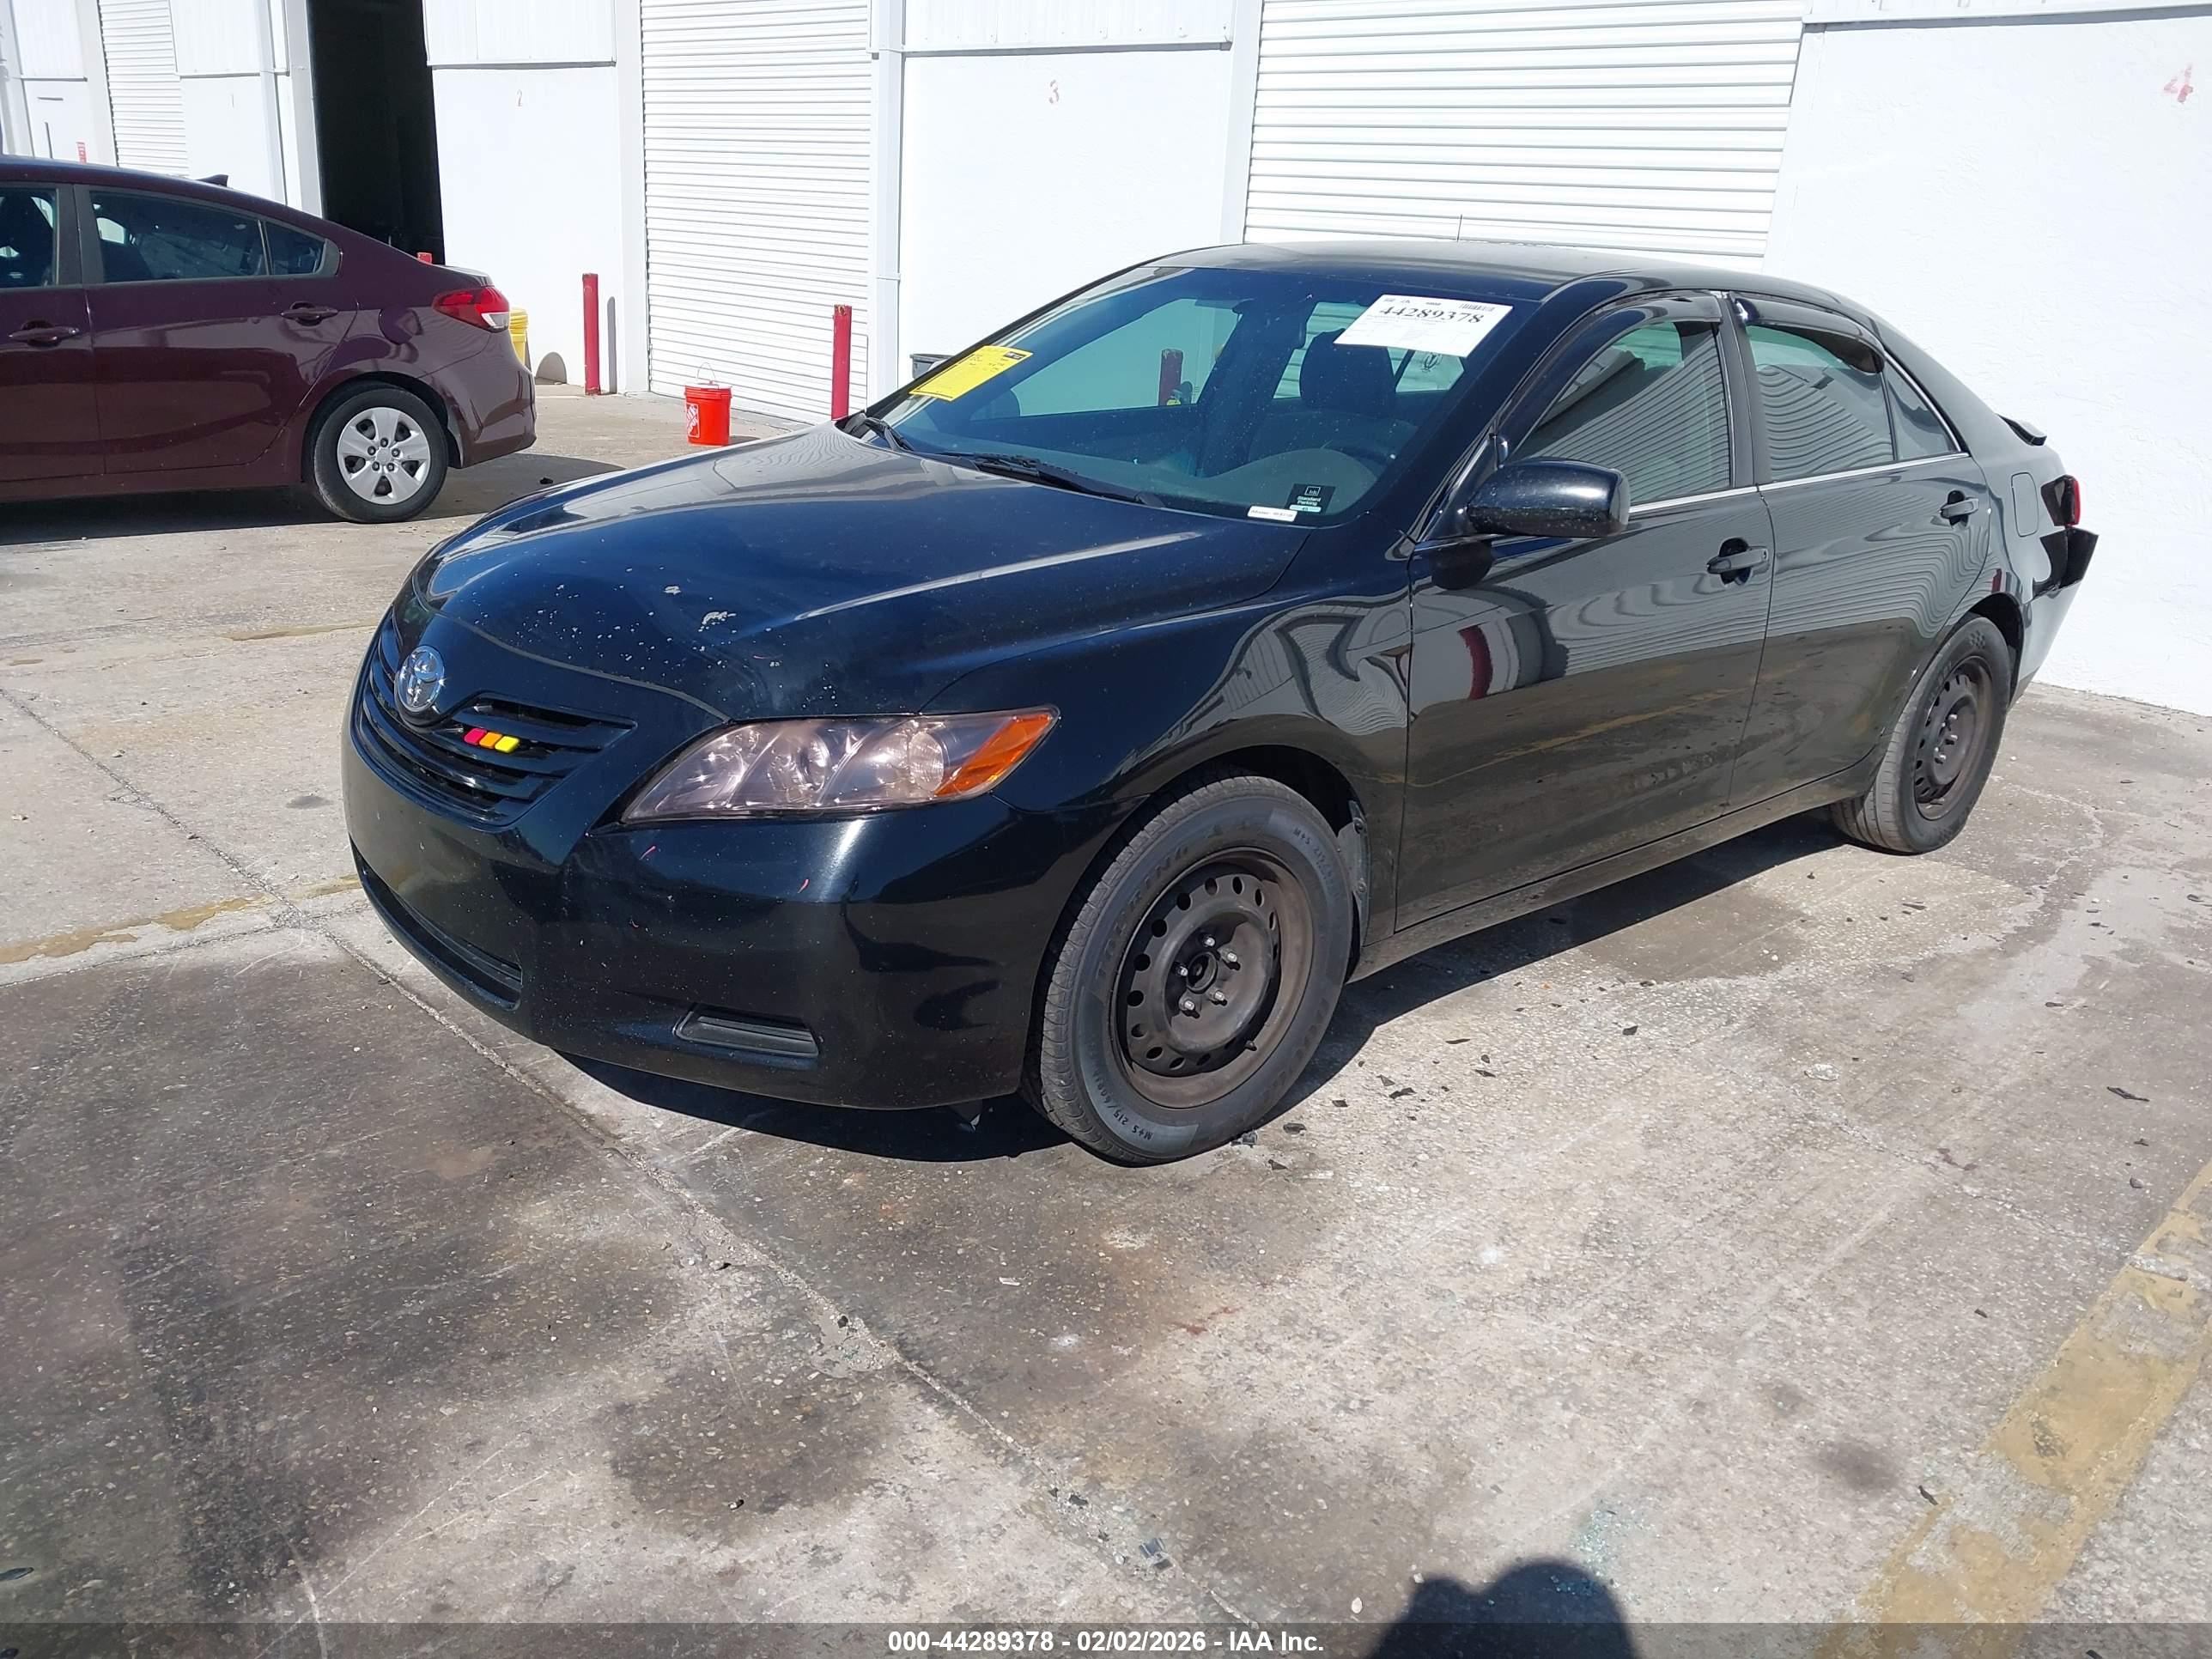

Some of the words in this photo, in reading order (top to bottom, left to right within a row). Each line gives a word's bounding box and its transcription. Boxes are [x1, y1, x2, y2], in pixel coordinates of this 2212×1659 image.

[1048, 79, 1060, 104] 3
[2163, 64, 2194, 103] 4
[1379, 305, 1485, 324] 44289378
[1131, 1124, 1153, 1140] M+S
